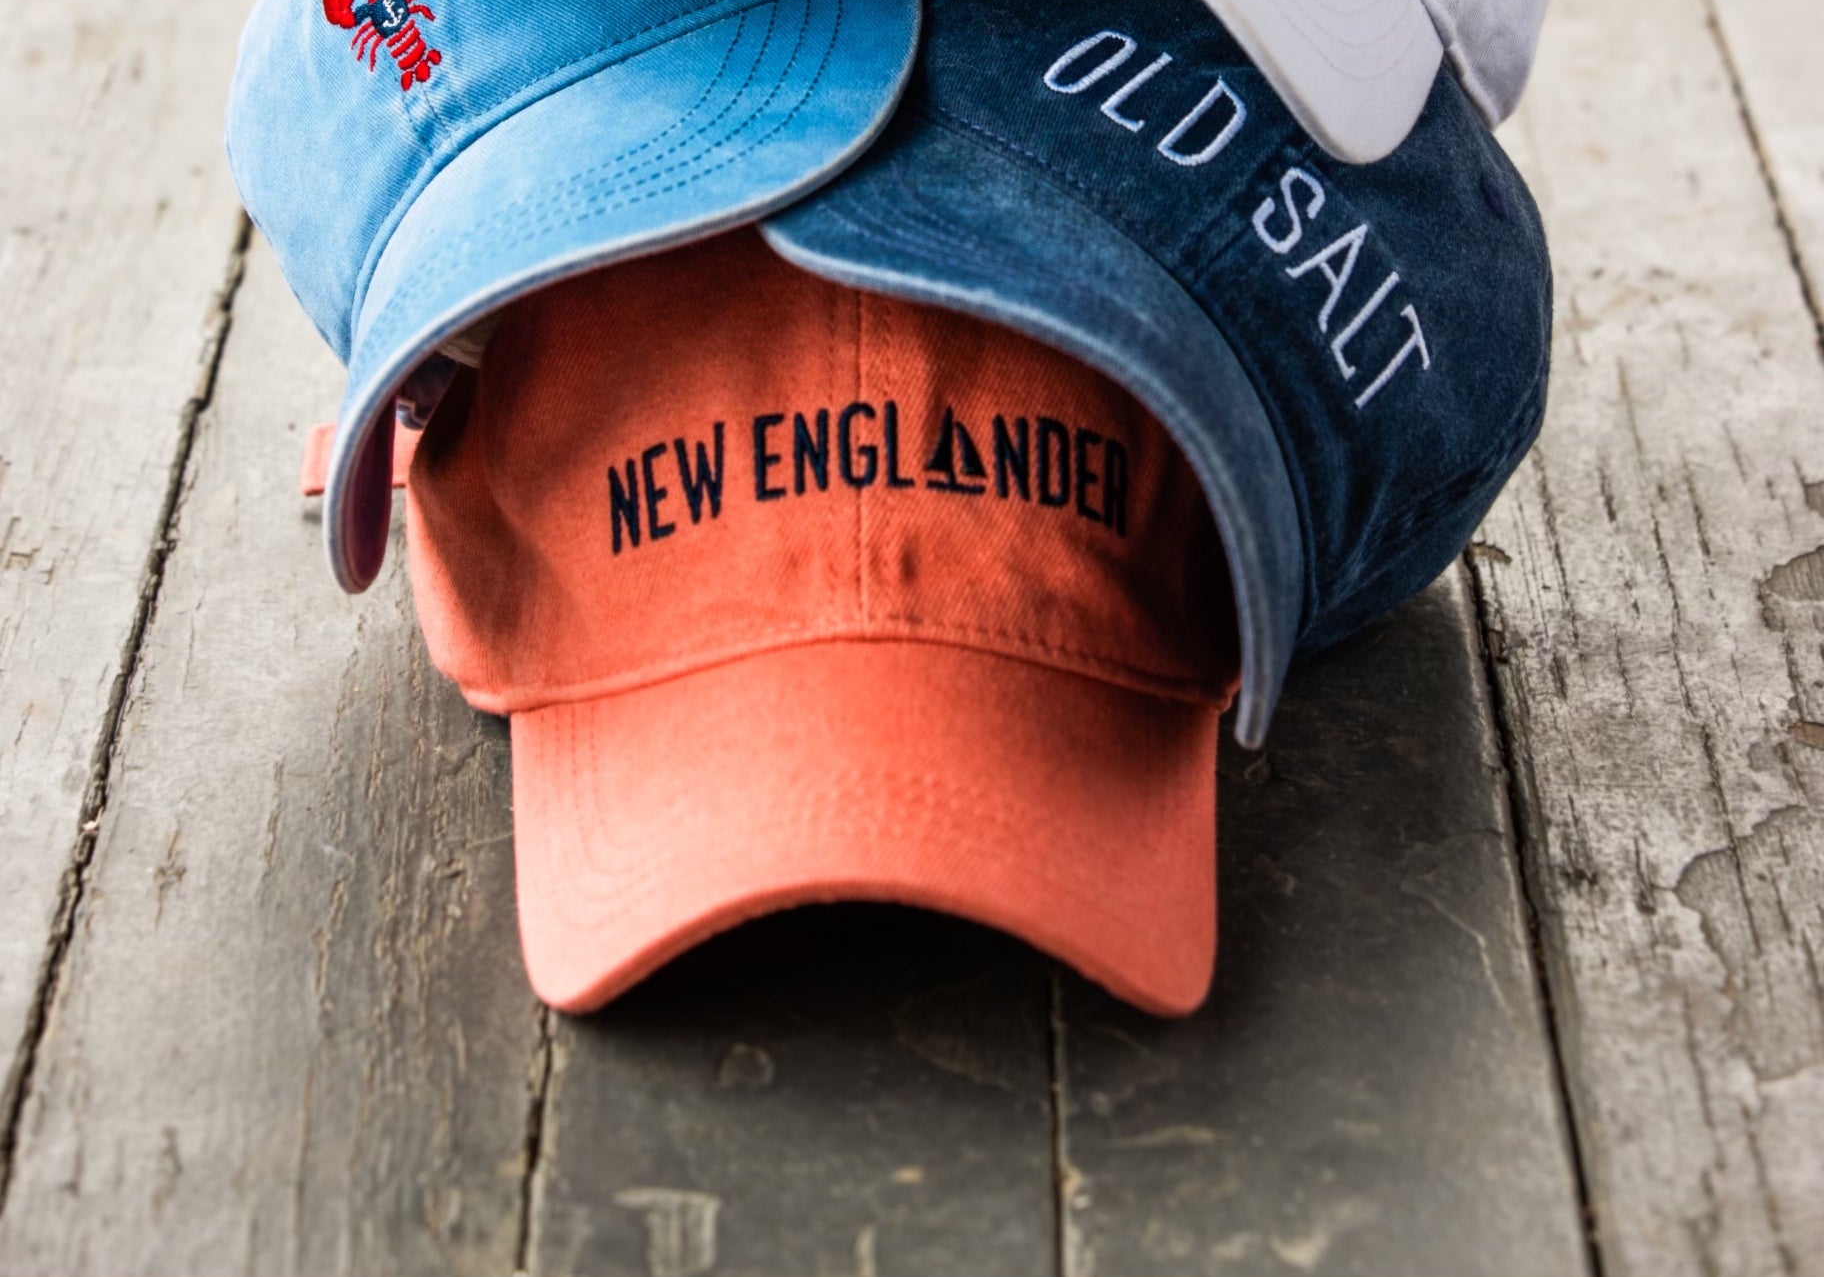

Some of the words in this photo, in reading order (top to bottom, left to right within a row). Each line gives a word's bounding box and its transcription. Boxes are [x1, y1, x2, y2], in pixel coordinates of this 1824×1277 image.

[1043, 30, 1247, 166] OLD
[1252, 166, 1430, 409] SALT
[608, 422, 724, 555] NEW
